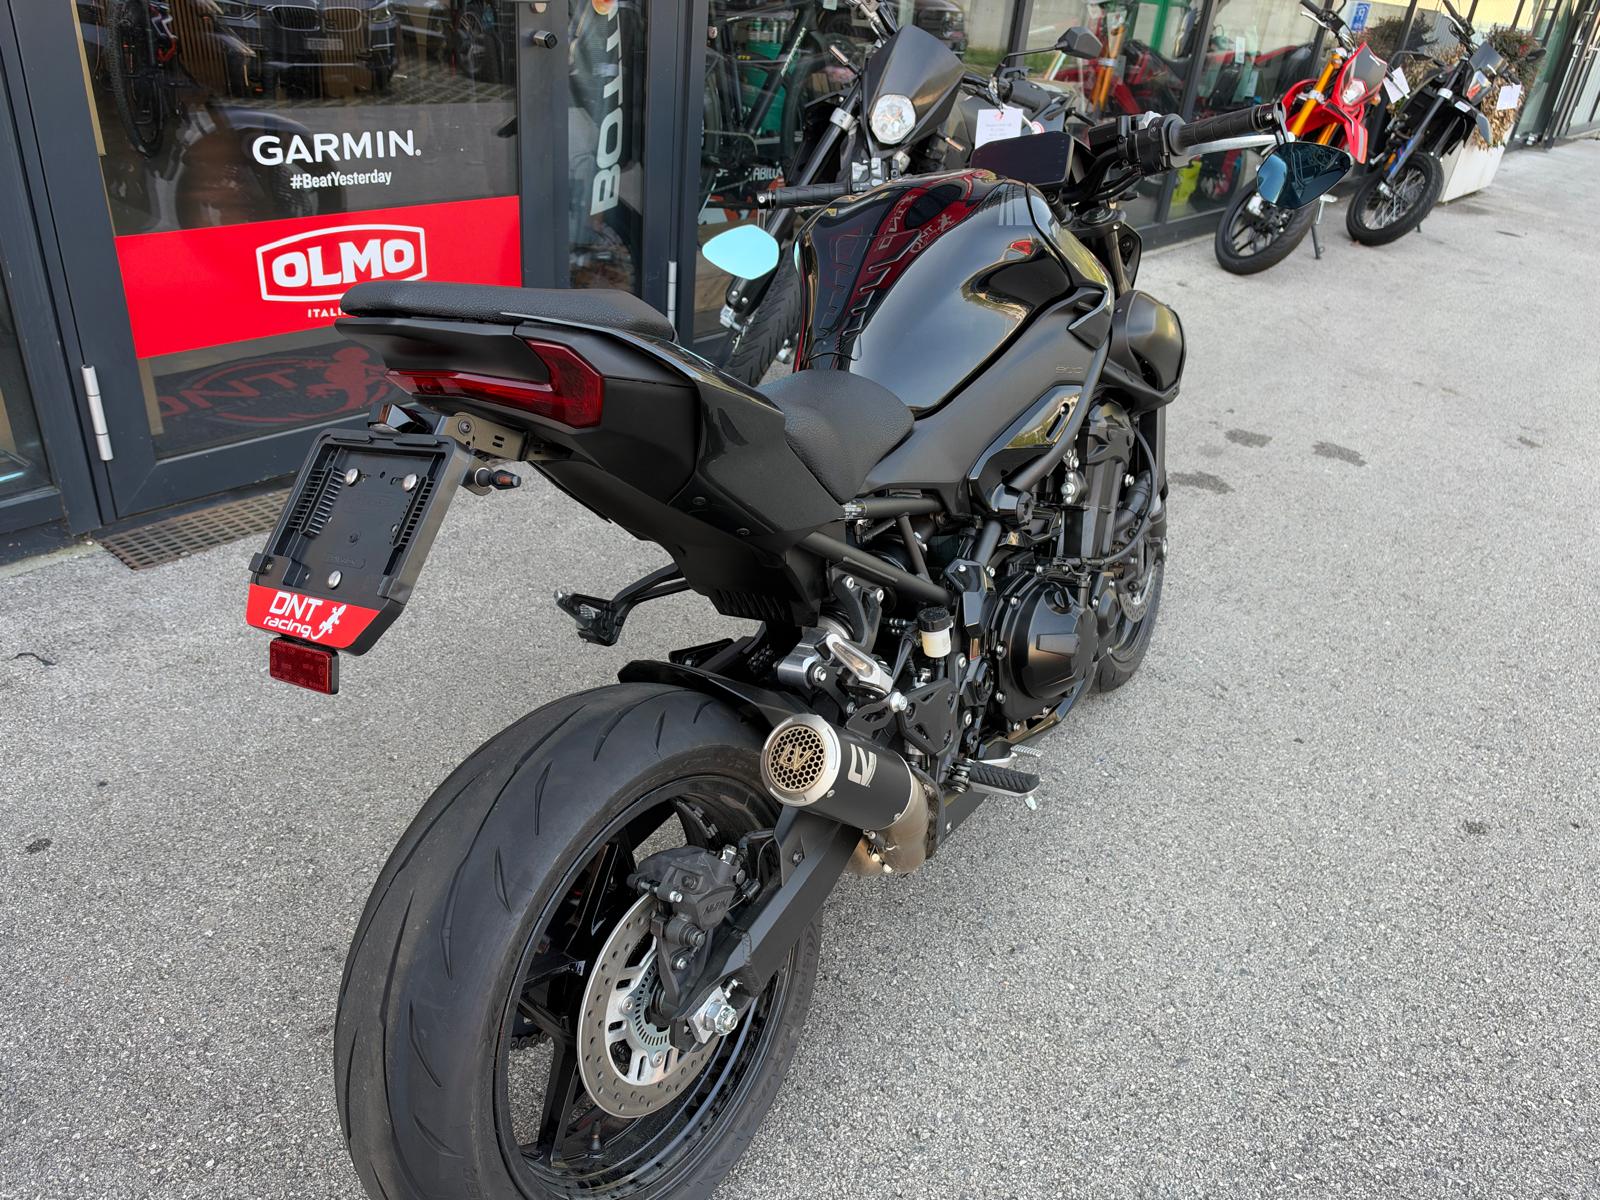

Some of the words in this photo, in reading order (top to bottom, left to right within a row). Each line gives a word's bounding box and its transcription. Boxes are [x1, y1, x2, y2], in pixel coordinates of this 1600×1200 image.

[289, 168, 393, 190] #BeatYesterday
[271, 238, 416, 288] OLMO
[307, 307, 346, 319] ITALI
[268, 591, 324, 622] DNT
[263, 615, 312, 638] racing
